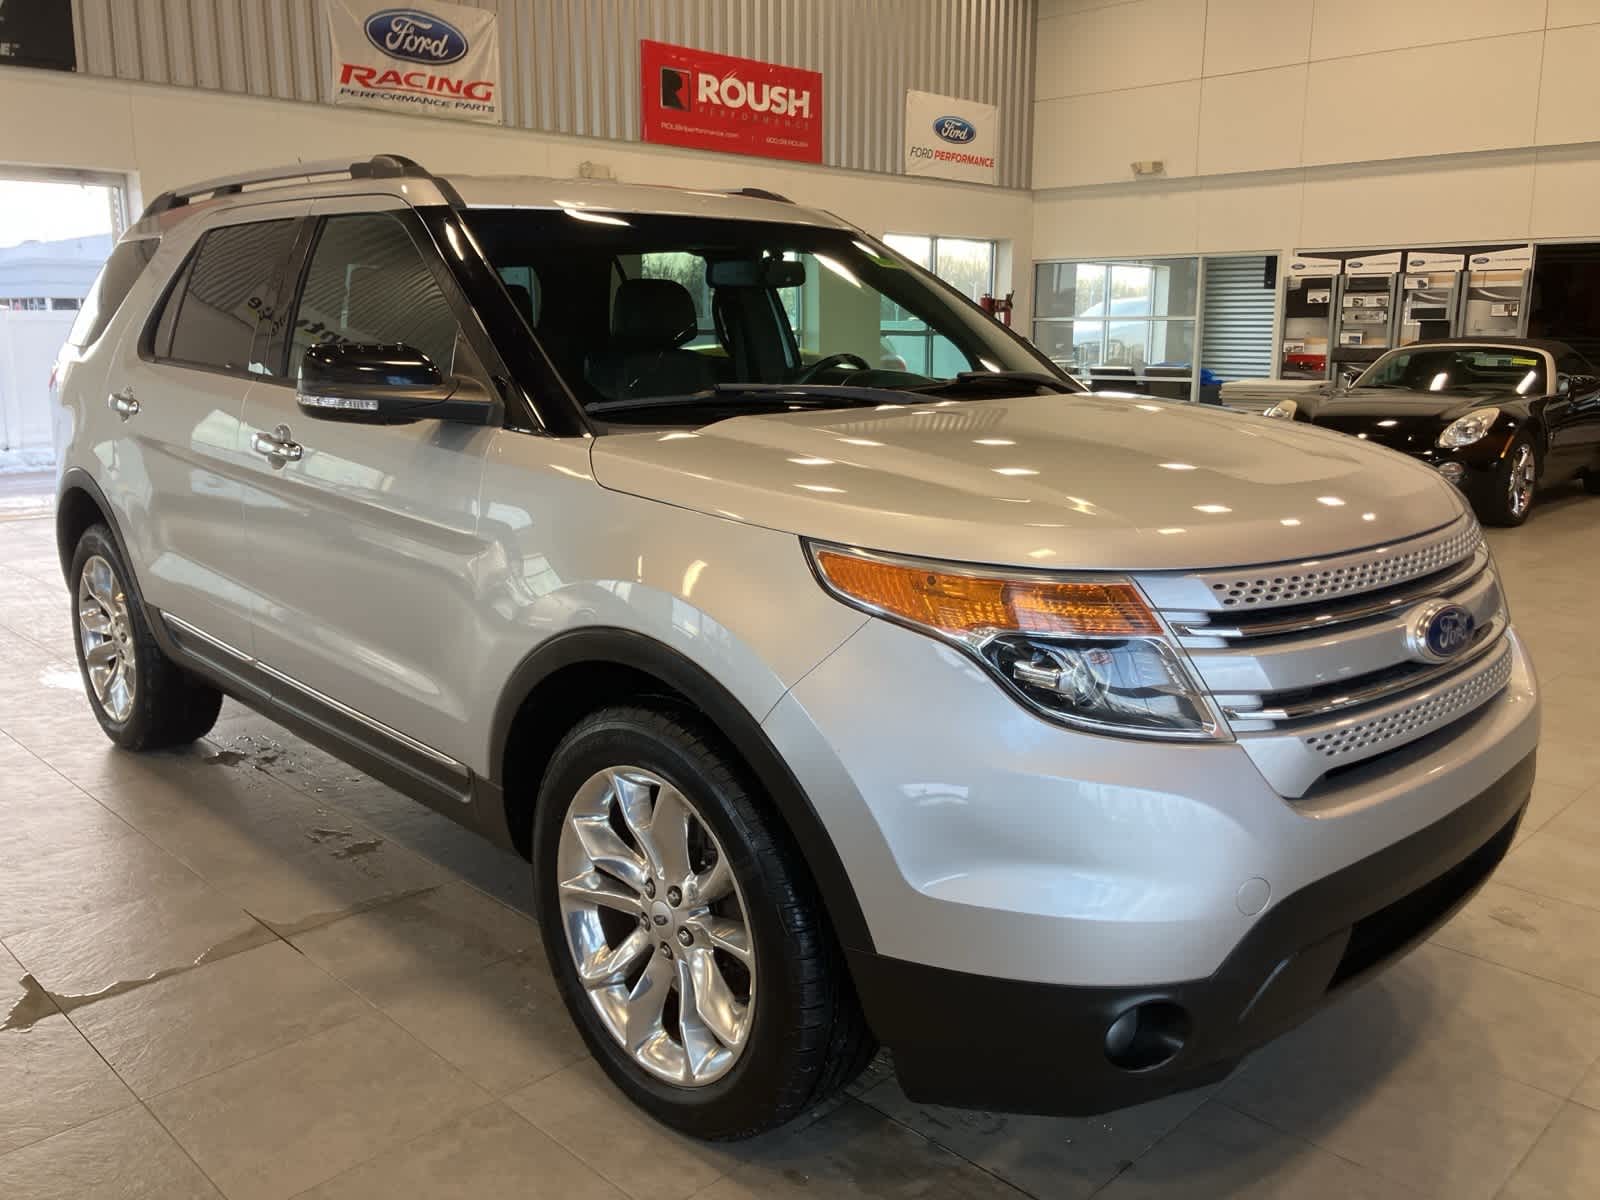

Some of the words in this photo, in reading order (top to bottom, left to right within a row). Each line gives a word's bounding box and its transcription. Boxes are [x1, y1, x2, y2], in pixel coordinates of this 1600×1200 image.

[385, 16, 450, 58] Ford
[339, 63, 495, 102] RACING
[697, 70, 811, 119] ROUSH
[339, 87, 451, 109] PERFORMANCE
[454, 101, 495, 113] PARTS
[940, 119, 968, 140] Ford
[910, 146, 933, 159] FORD
[934, 150, 995, 168] PERFORMANCE
